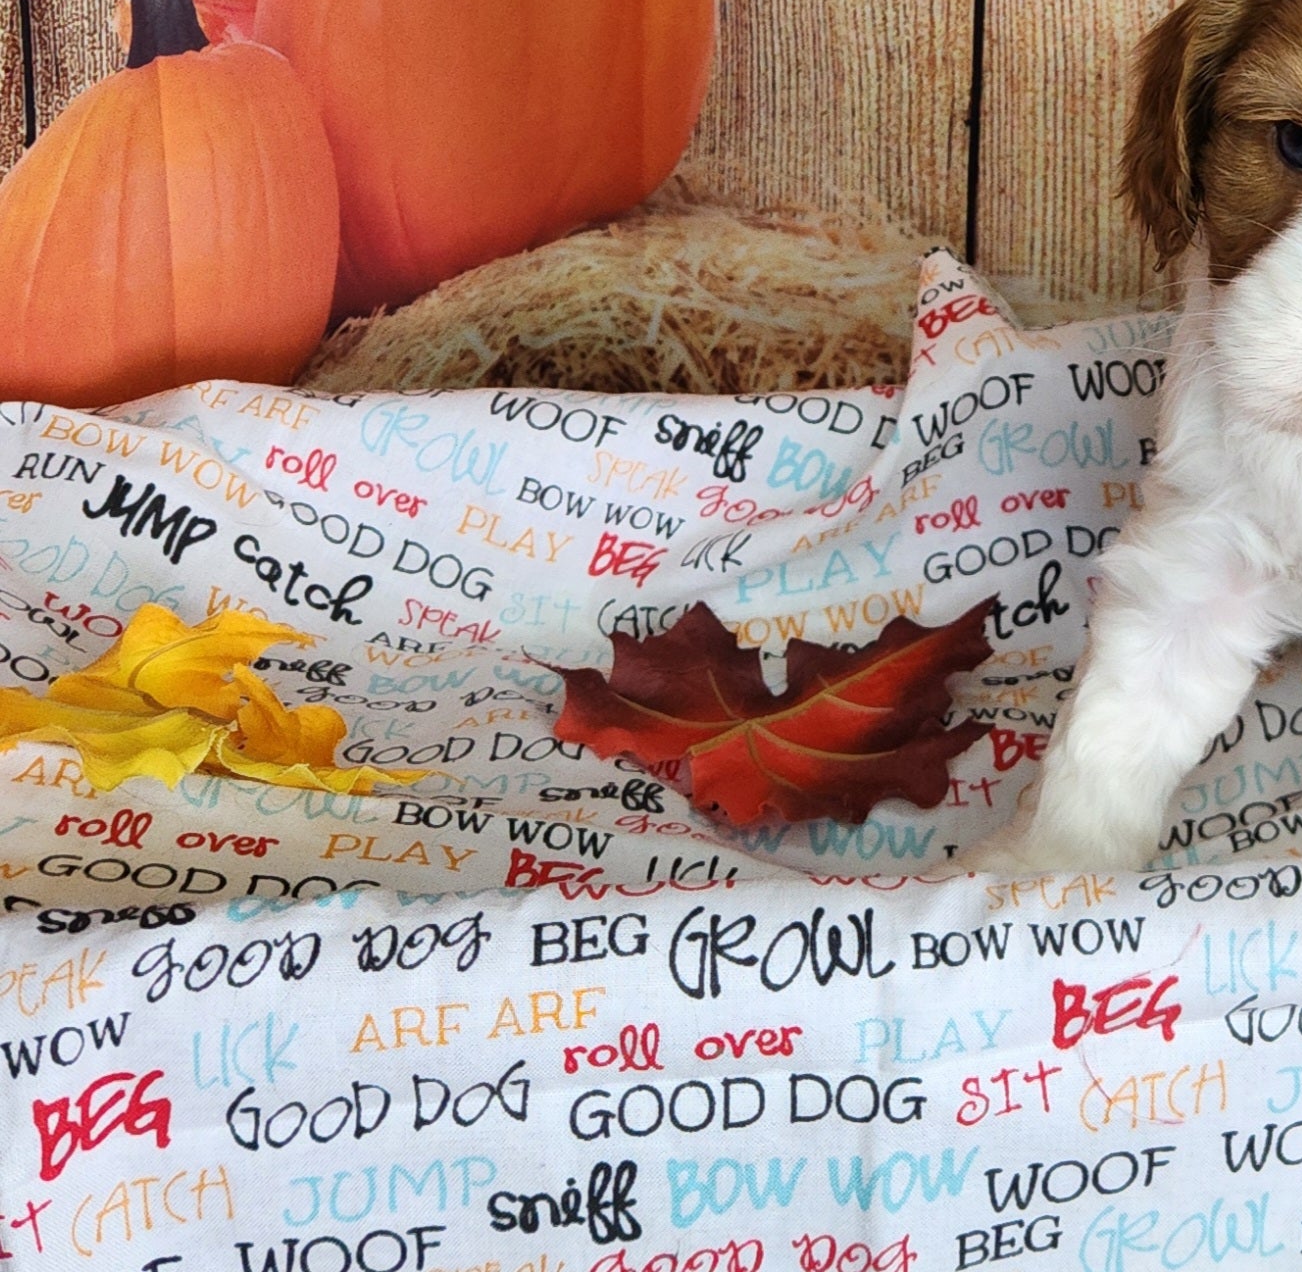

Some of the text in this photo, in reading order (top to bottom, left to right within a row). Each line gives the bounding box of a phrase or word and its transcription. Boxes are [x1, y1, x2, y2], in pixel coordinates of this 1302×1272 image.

[921, 277, 966, 306] OW
[188, 380, 240, 410] RF
[237, 393, 320, 431] ARF
[490, 391, 627, 447] WOOF
[911, 373, 1035, 448] WOOF
[13, 452, 106, 484] RUN
[40, 414, 146, 458] BOW
[160, 439, 265, 510] WOW
[362, 399, 506, 496] GROWL
[586, 450, 690, 500] SPEAK
[655, 414, 763, 483] sniff
[901, 432, 965, 488] BEG
[977, 417, 1131, 476] GROWL
[265, 445, 428, 518] roll over
[516, 476, 685, 540] BOW WOW
[914, 487, 1071, 534] roll over
[83, 474, 217, 566] JUMP
[456, 504, 574, 564] PLAY
[233, 534, 374, 625] catch
[392, 539, 495, 602] DOG
[587, 531, 668, 589] BEG
[736, 532, 899, 605] PLAY
[924, 529, 1053, 585] GOOD
[401, 599, 502, 644] SPEAK
[823, 585, 926, 633] WOW
[342, 735, 475, 765] GOOD
[539, 779, 667, 813] sniff
[54, 808, 281, 858] roll over
[321, 833, 480, 872] PLAY
[393, 801, 494, 835] BOW
[507, 817, 615, 859] WOW
[808, 817, 937, 861] WOW
[37, 854, 228, 896] GOOD
[984, 873, 1118, 913] SPEAK
[530, 912, 650, 968] BEG
[668, 905, 896, 1000] GROWL
[911, 916, 1147, 970] BOW WOW
[351, 986, 607, 1054] ARF ARF
[854, 1007, 1013, 1066] PLAY
[1052, 975, 1183, 1051] BEG
[1, 1011, 133, 1080] WOW
[192, 1011, 300, 1090] LICK
[563, 1022, 804, 1075] roll over
[226, 1059, 531, 1152] GOOD DOG
[569, 1073, 928, 1141] GOOD DOG
[1079, 1058, 1228, 1133] CATCH
[33, 1069, 173, 1183] BEG
[283, 1154, 498, 1228] JUMP
[487, 1159, 643, 1245] sniff
[666, 1144, 982, 1229] BOW WOW
[984, 1145, 1178, 1214] WOOF
[71, 1164, 237, 1259] CATCH
[1078, 1191, 1285, 1272] GROWL
[235, 1224, 446, 1272] WOOF
[955, 1214, 1063, 1271] BEG
